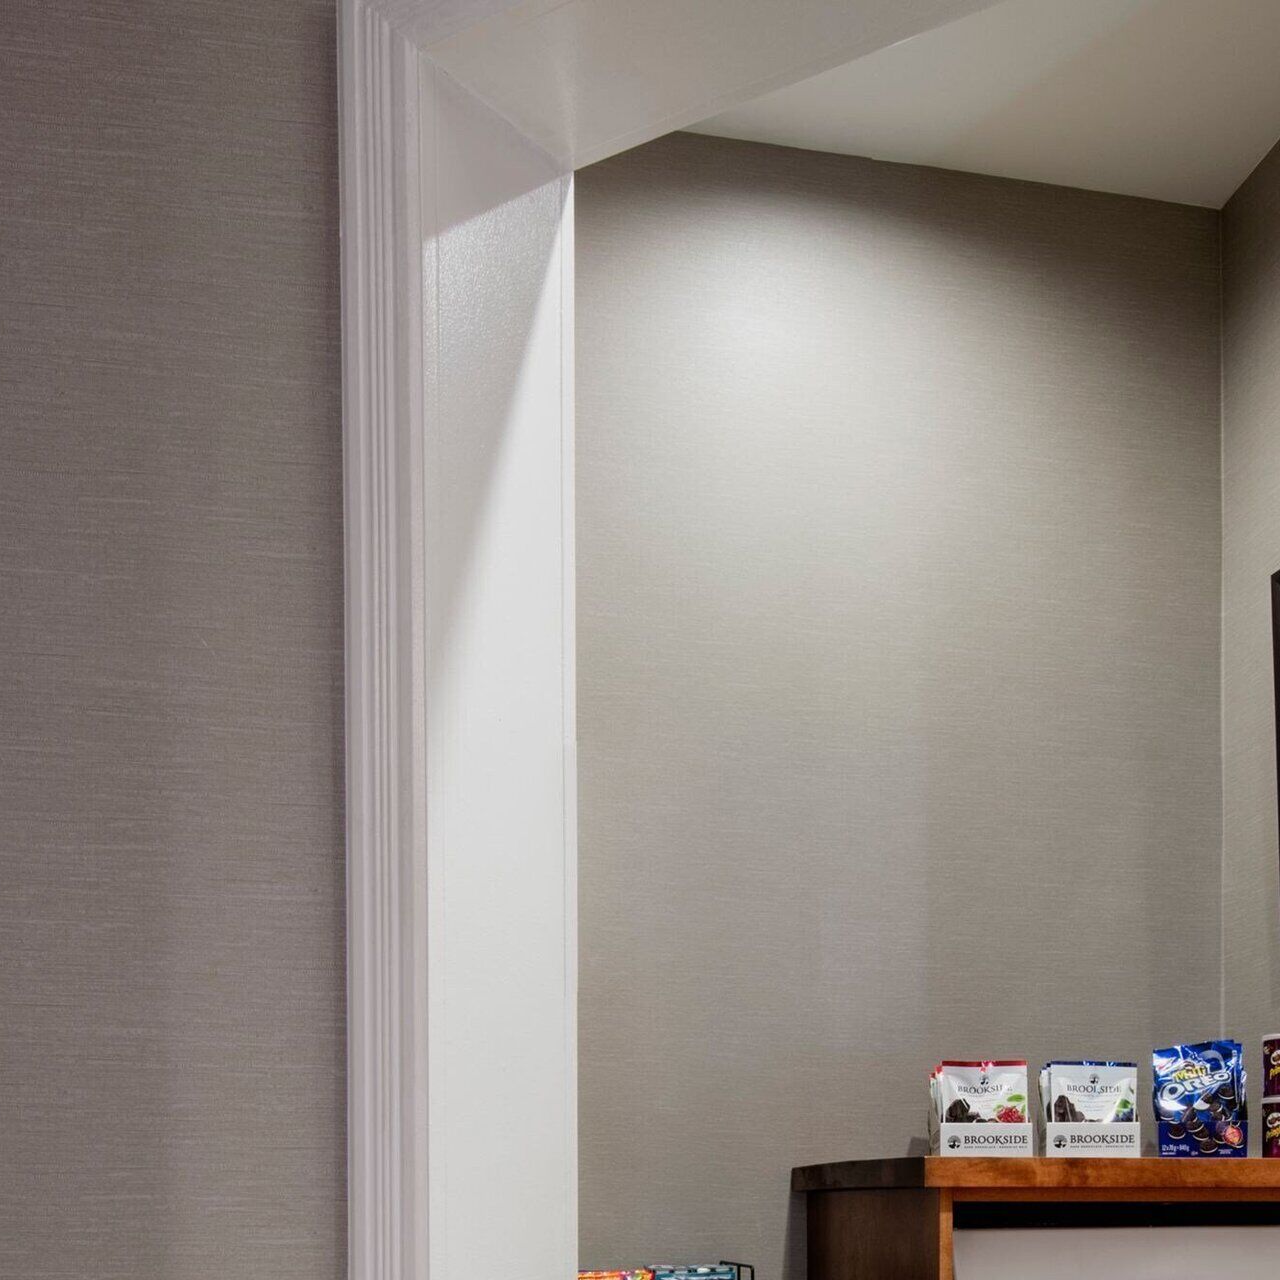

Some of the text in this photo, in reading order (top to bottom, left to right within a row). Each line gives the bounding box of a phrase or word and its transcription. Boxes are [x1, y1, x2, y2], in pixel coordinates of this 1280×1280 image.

[1162, 1071, 1231, 1100] OREO
[964, 1135, 1028, 1145] BROOKSIDE
[1070, 1134, 1135, 1144] BROOKSIDE
